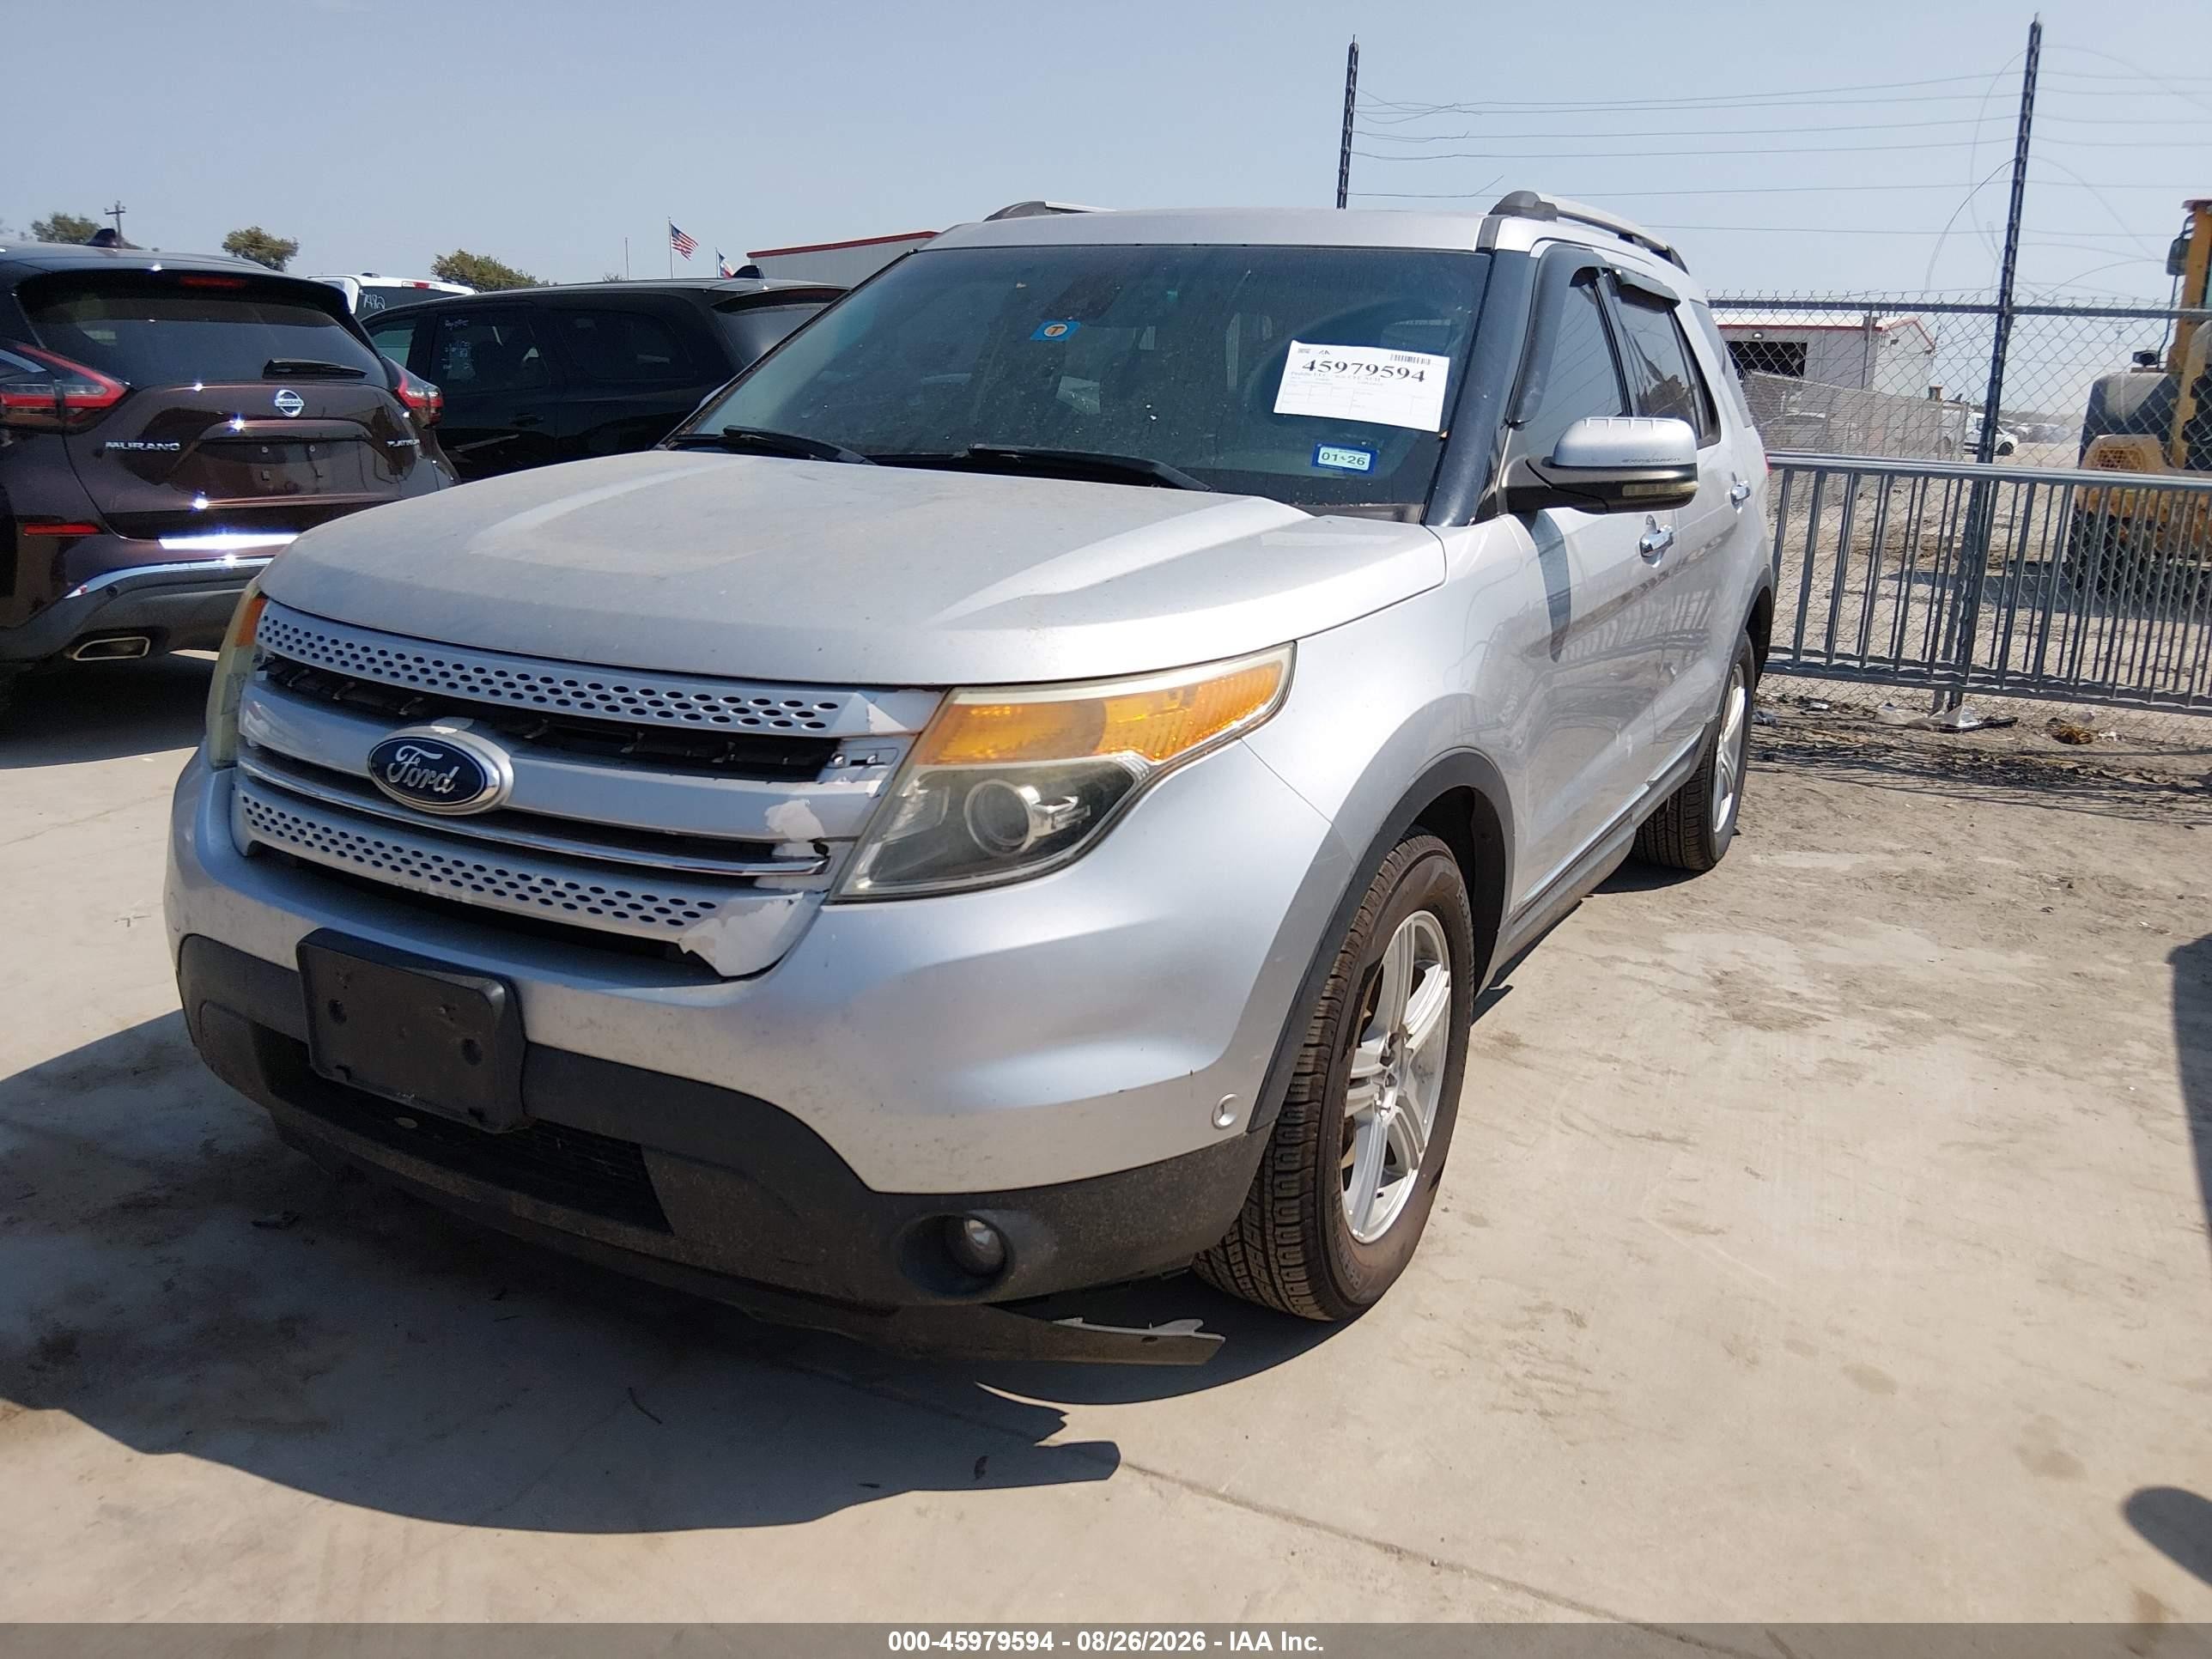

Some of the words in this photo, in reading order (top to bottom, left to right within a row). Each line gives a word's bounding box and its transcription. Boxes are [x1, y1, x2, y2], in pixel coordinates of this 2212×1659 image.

[1302, 359, 1425, 382] 45979594
[105, 441, 181, 451] MURANO
[386, 744, 460, 794] Ford
